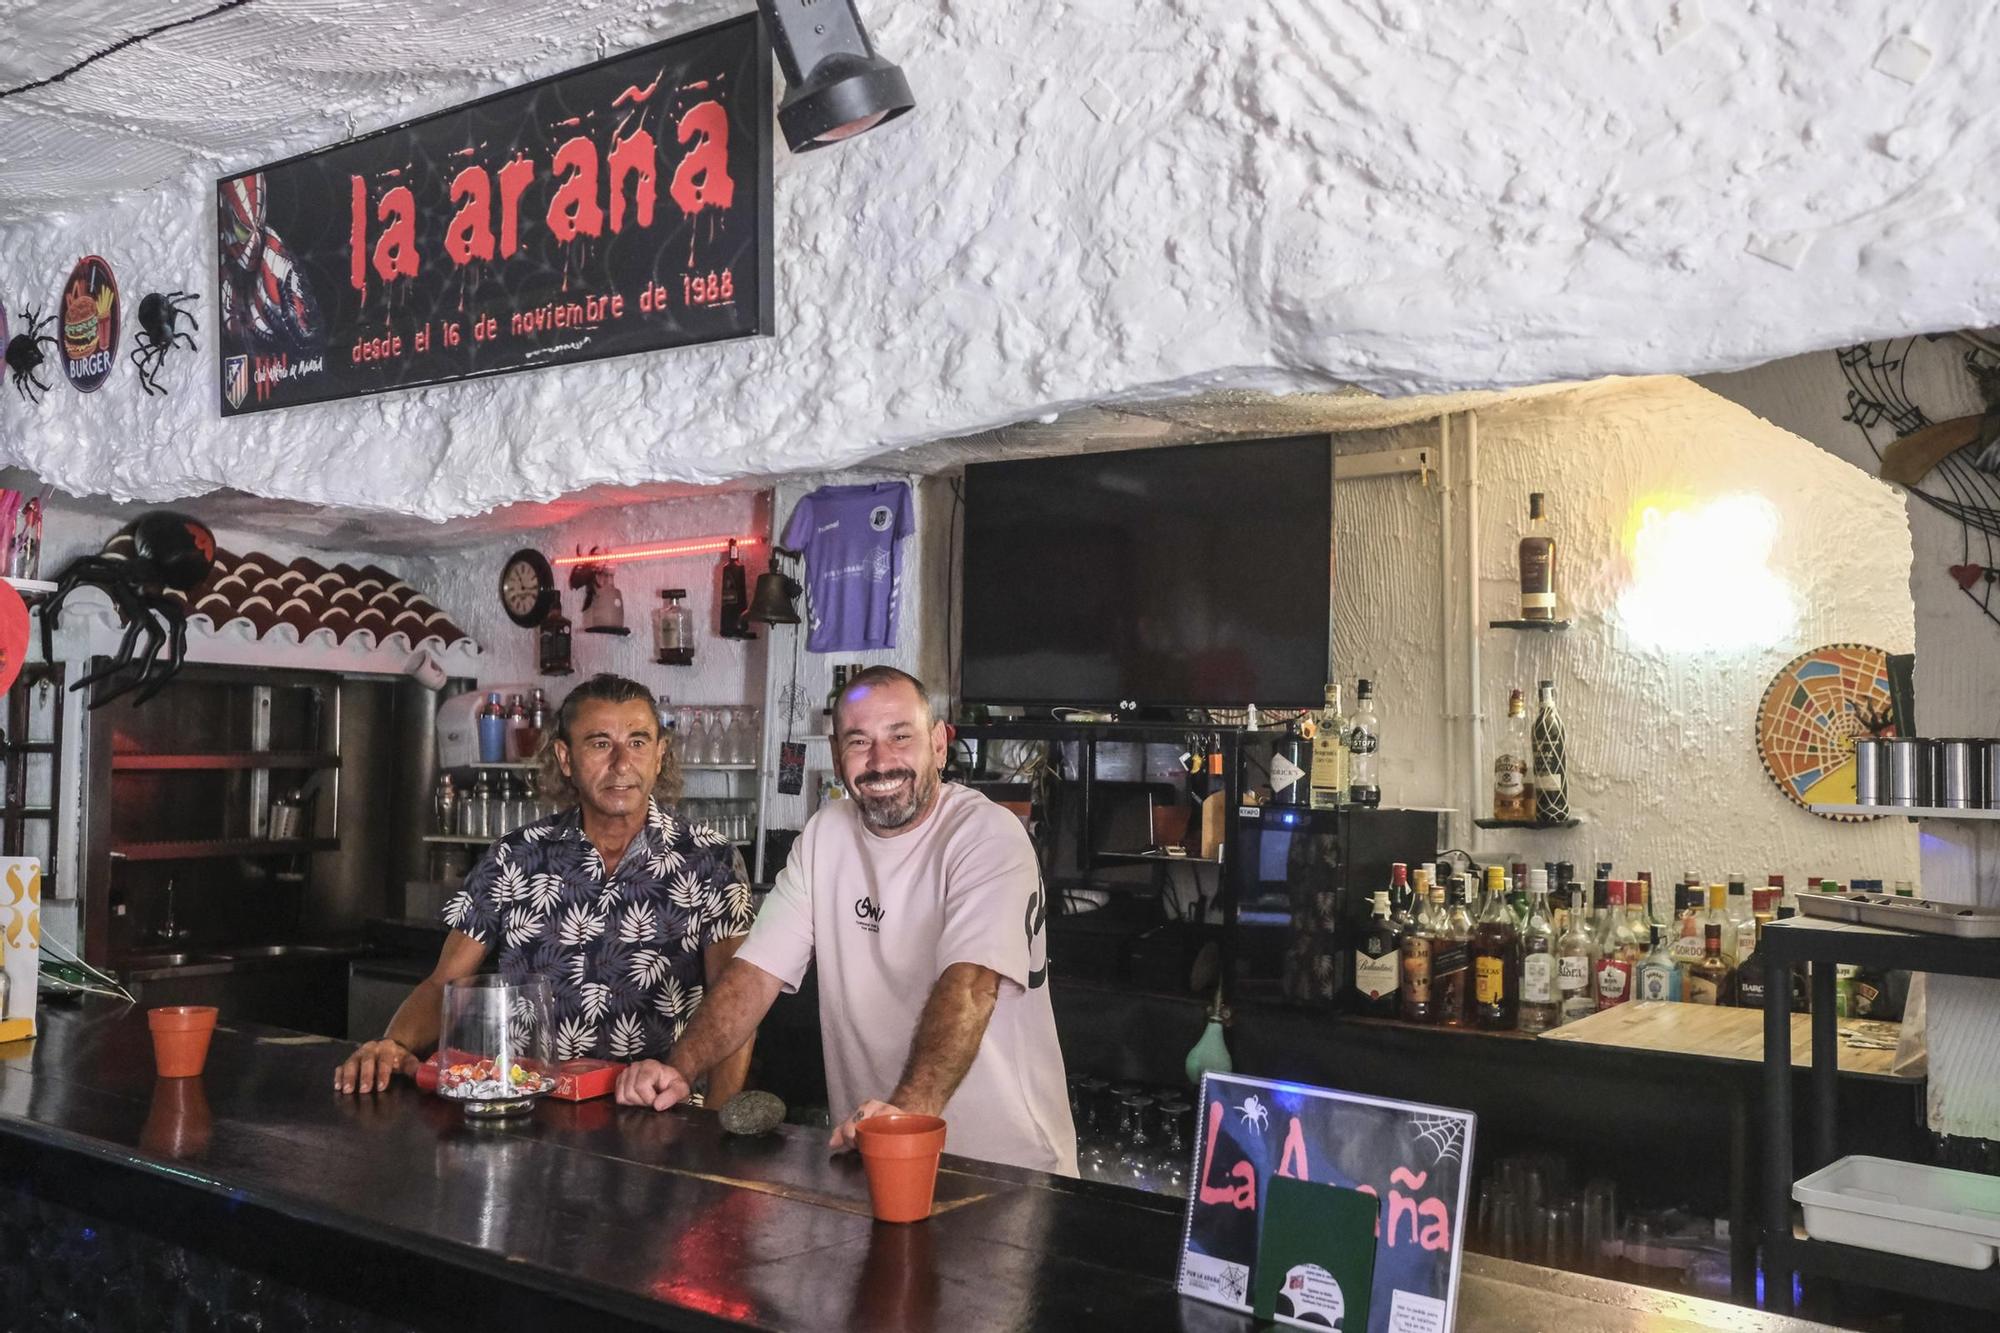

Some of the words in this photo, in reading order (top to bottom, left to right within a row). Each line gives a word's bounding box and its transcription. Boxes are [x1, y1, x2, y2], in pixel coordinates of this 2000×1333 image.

[350, 172, 420, 294] la
[444, 70, 735, 268] araña
[69, 350, 112, 378] BURGER
[352, 334, 402, 364] desde
[414, 323, 430, 352] el
[443, 318, 460, 347] 16
[474, 314, 497, 340] de
[511, 294, 624, 336] noviembre
[640, 283, 667, 314] de
[684, 269, 734, 304] 1988
[1199, 1100, 1256, 1212] La
